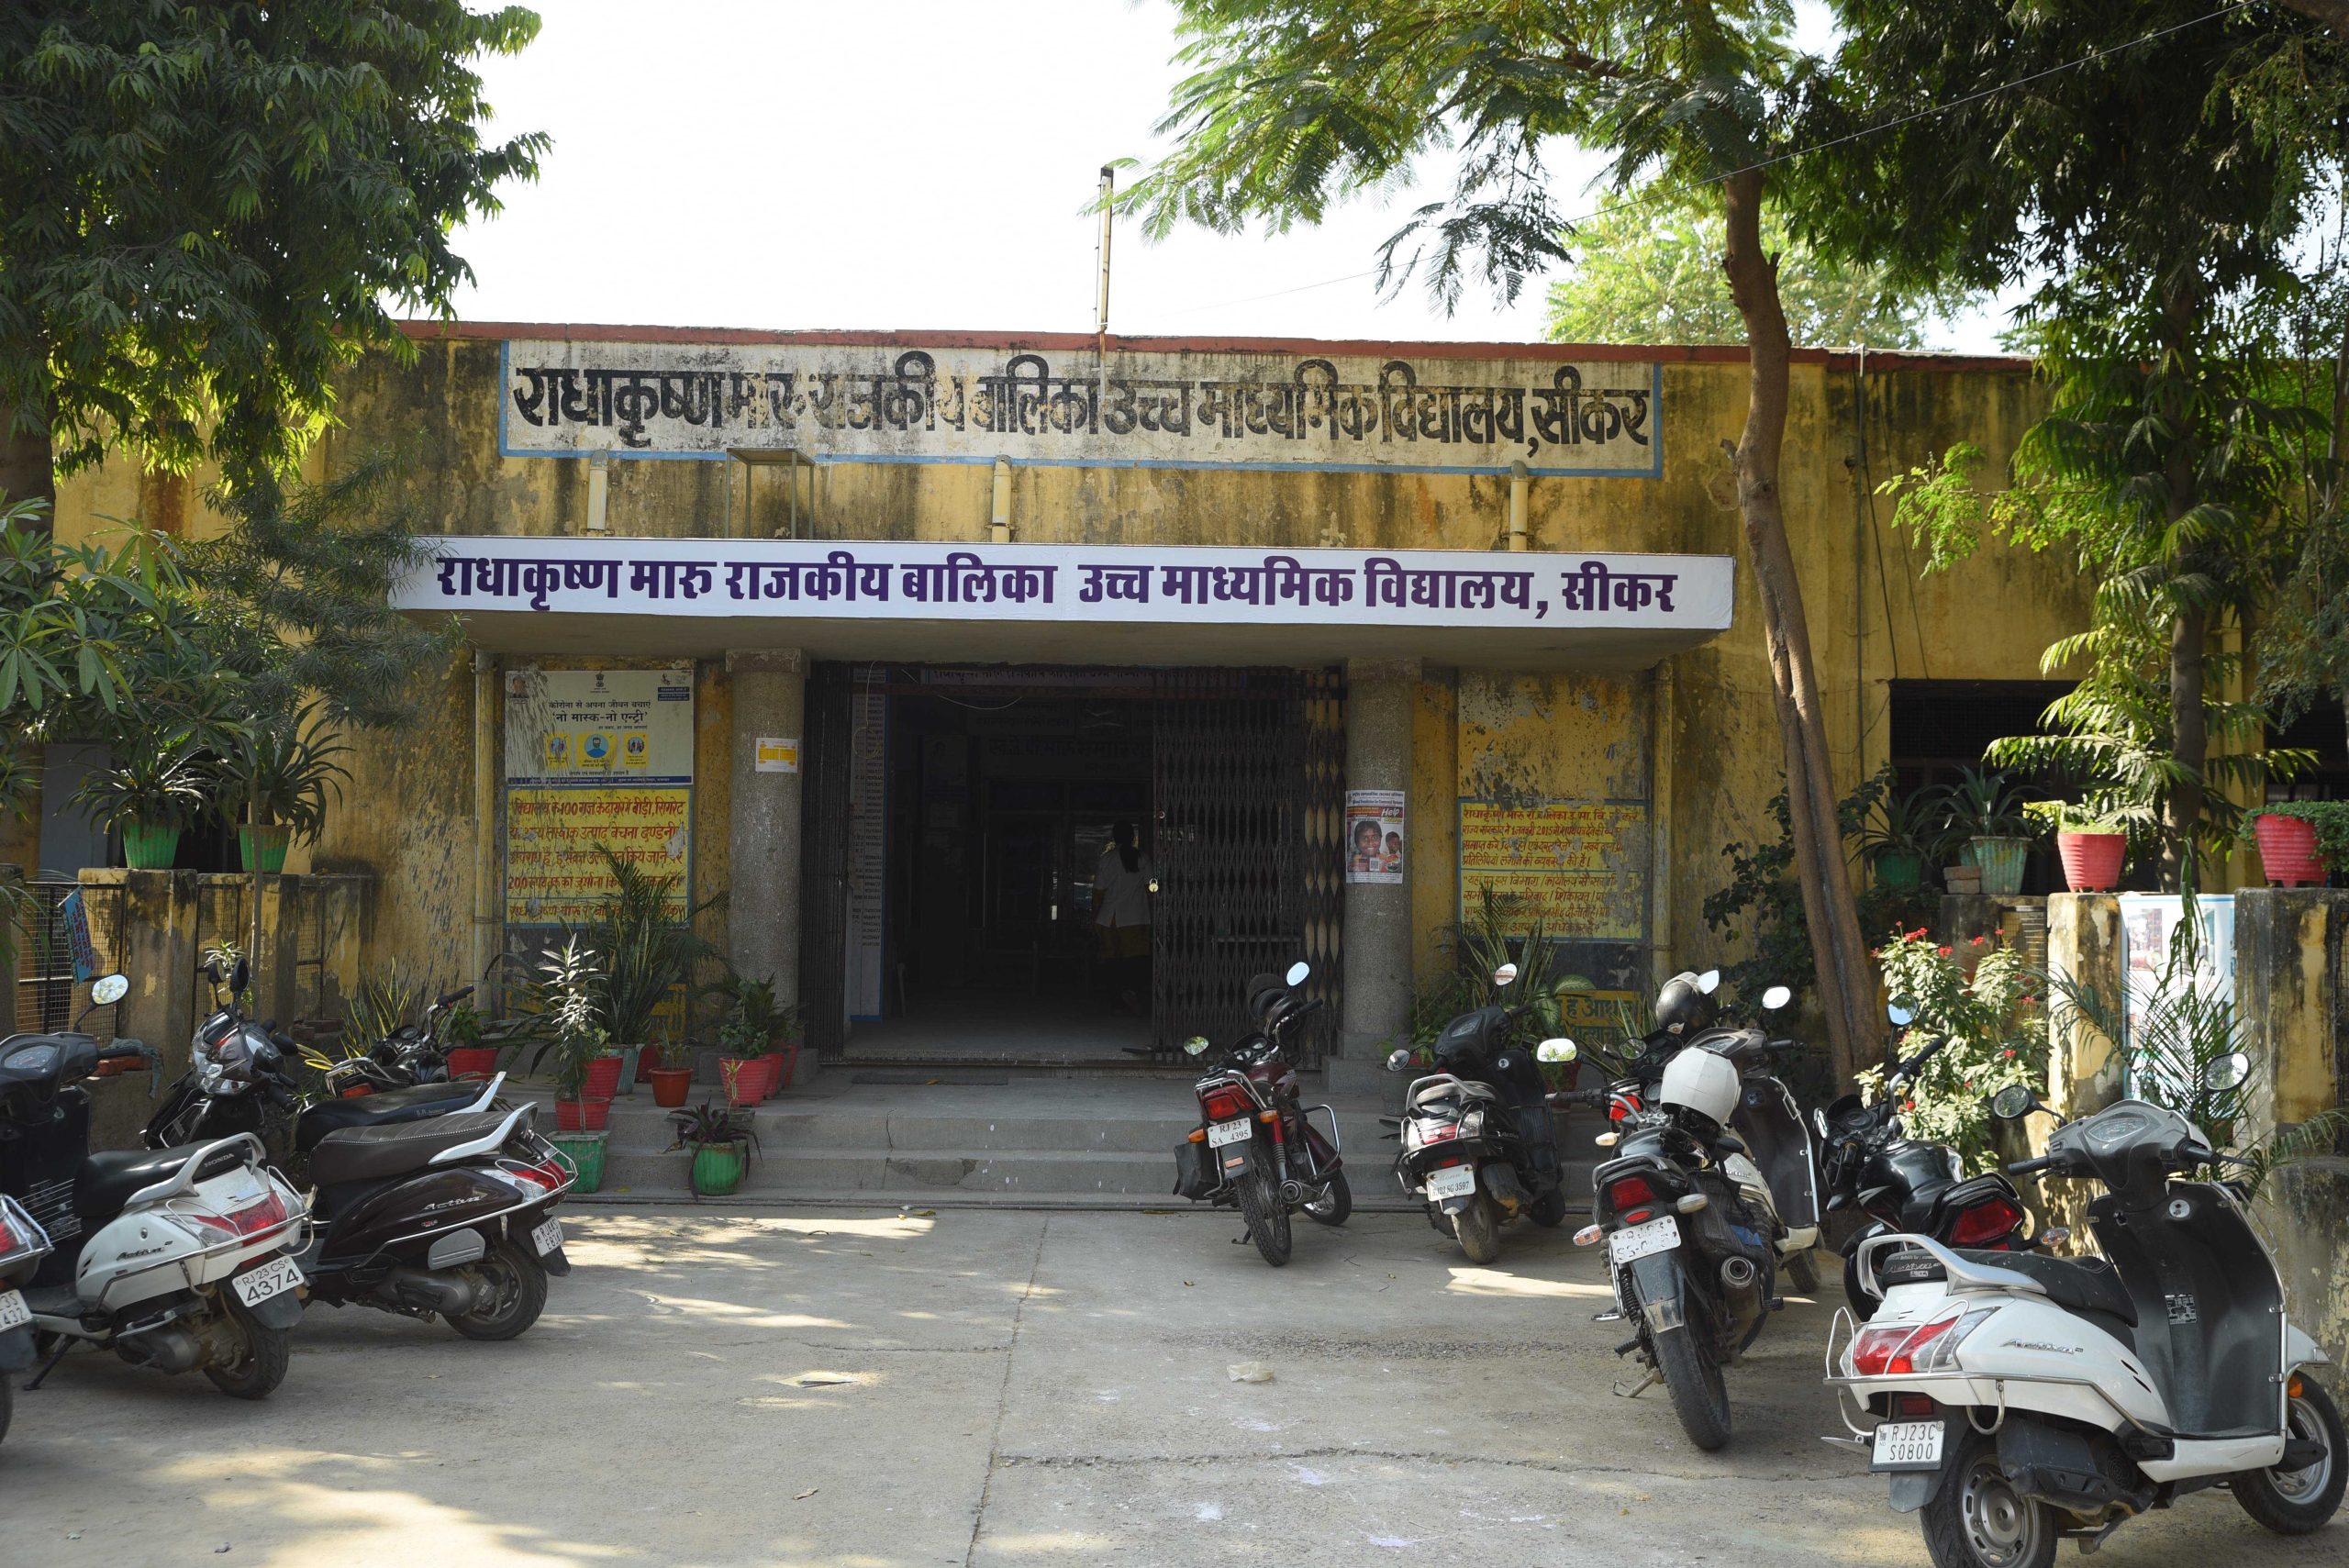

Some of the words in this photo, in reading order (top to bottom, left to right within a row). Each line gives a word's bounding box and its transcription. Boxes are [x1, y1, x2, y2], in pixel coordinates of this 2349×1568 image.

[513, 368, 723, 448] राधाकृष्ण
[970, 354, 1098, 436] बालिका
[1104, 378, 1195, 437] उच्च
[1197, 359, 1378, 440] माध्यमिक
[1531, 365, 1650, 446] सीकर
[436, 558, 623, 611] राधाकृष्ण
[724, 550, 894, 601] राजकीय
[901, 552, 1058, 603] बालिका
[1078, 564, 1153, 603] उच्च
[1161, 555, 1355, 606] माध्यमिक
[1364, 557, 1549, 618] विद्यालय,
[1562, 562, 1678, 612] सीकर
[575, 700, 583, 708] से
[1381, 807, 1399, 821] Help
[1219, 1123, 1230, 1133] RJ
[1232, 1120, 1241, 1130] 23
[1211, 1137, 1223, 1146] SA
[1230, 1129, 1249, 1141] 4395
[204, 1152, 235, 1168] HONDA
[1455, 1181, 1469, 1192] 3597
[242, 1274, 256, 1285] RJ
[256, 1268, 270, 1279] 23
[270, 1260, 286, 1272] CS
[247, 1268, 299, 1302] 4374
[1892, 1424, 1935, 1441] RJ23C
[1889, 1442, 1933, 1461] S0800
